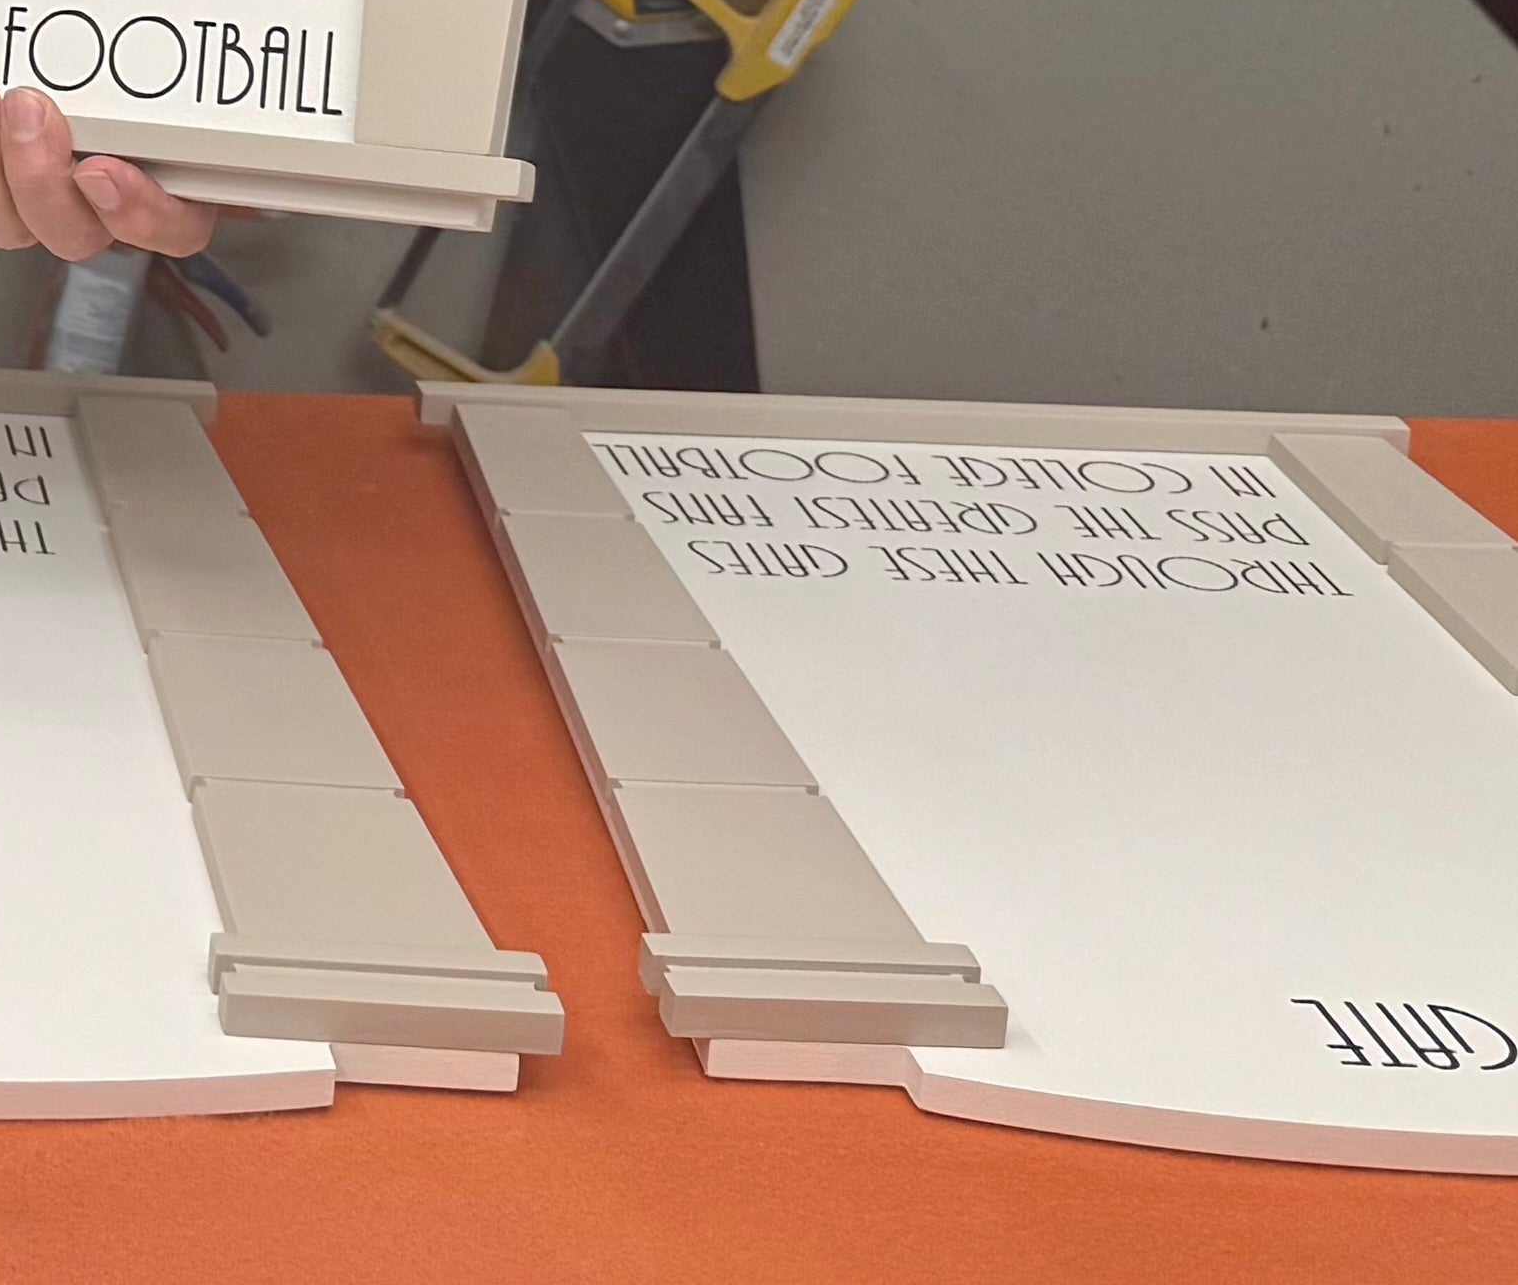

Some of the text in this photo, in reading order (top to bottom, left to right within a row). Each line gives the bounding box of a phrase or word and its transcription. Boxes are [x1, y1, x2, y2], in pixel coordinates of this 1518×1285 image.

[3, 7, 342, 116] FOOTBALL
[5, 425, 52, 458] IN
[592, 445, 1276, 498] IN COLLEGE FOOTBALL
[642, 492, 1310, 546] PASS THE GREATEST FANS
[687, 541, 1353, 596] THROUGH THESE GATES
[1290, 999, 1518, 1070] GATE
